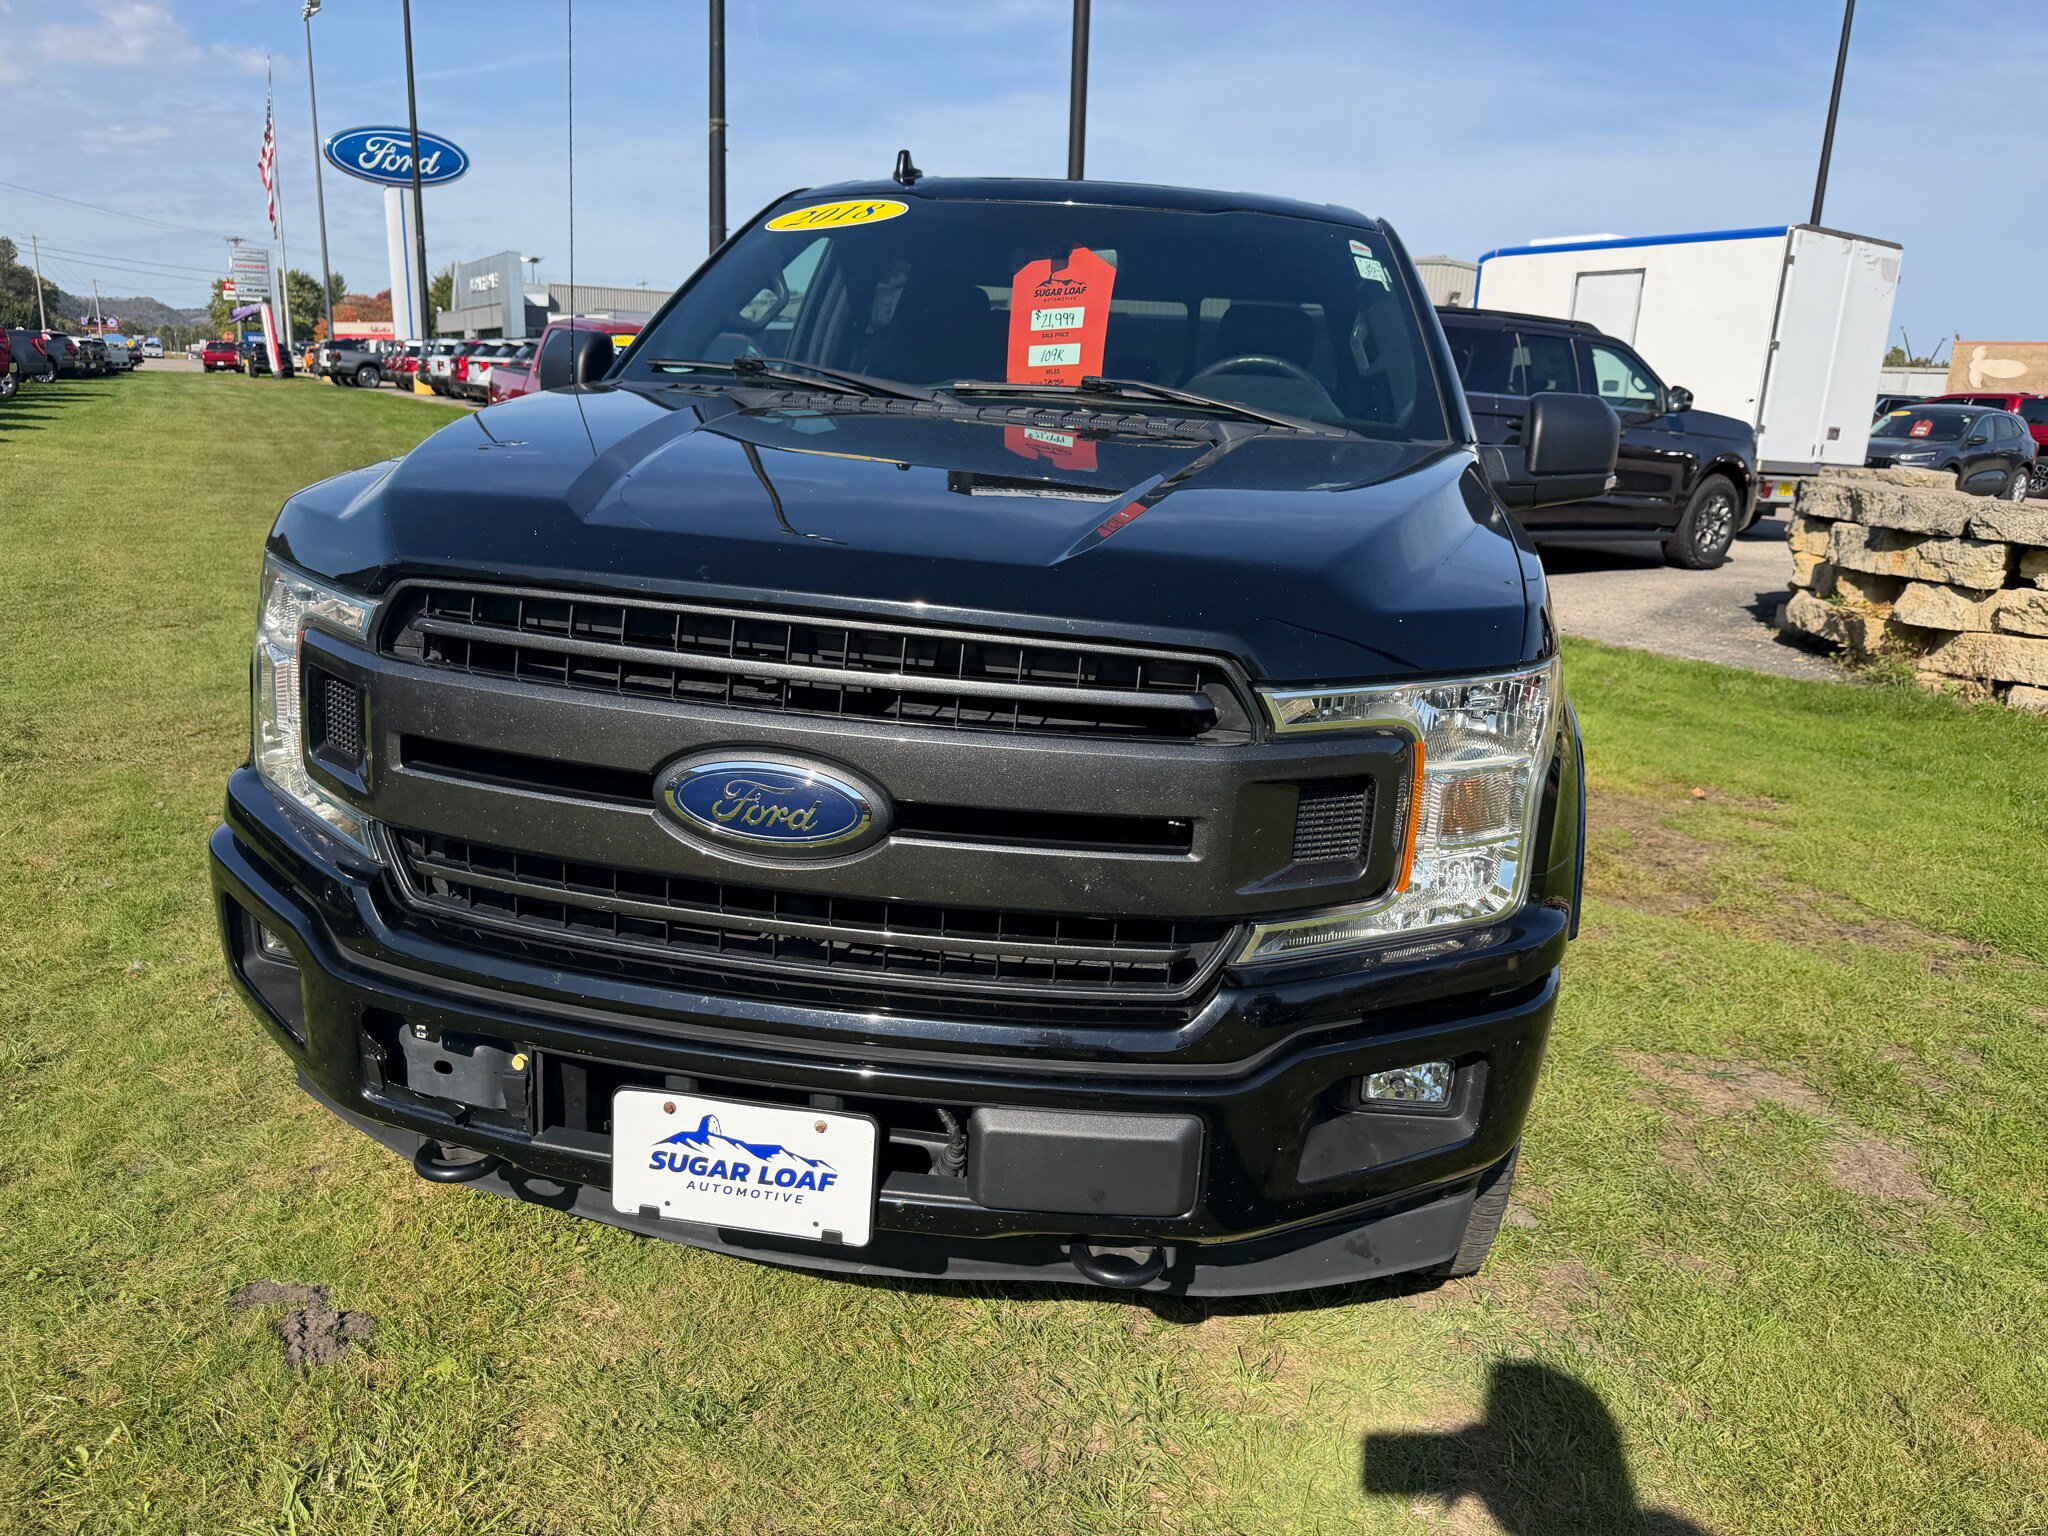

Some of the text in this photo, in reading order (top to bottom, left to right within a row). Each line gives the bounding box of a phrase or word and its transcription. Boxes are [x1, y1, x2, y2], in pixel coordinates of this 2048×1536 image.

[358, 136, 442, 175] Ford
[782, 203, 886, 228] 2018
[1033, 285, 1087, 298] SUGAR LOAF
[1035, 309, 1075, 329] $21,999
[1040, 348, 1065, 363] 109K
[712, 779, 822, 832] Ford
[648, 1150, 838, 1192] SUGAR LOAF
[686, 1180, 806, 1205] AUTOMOTIVE
